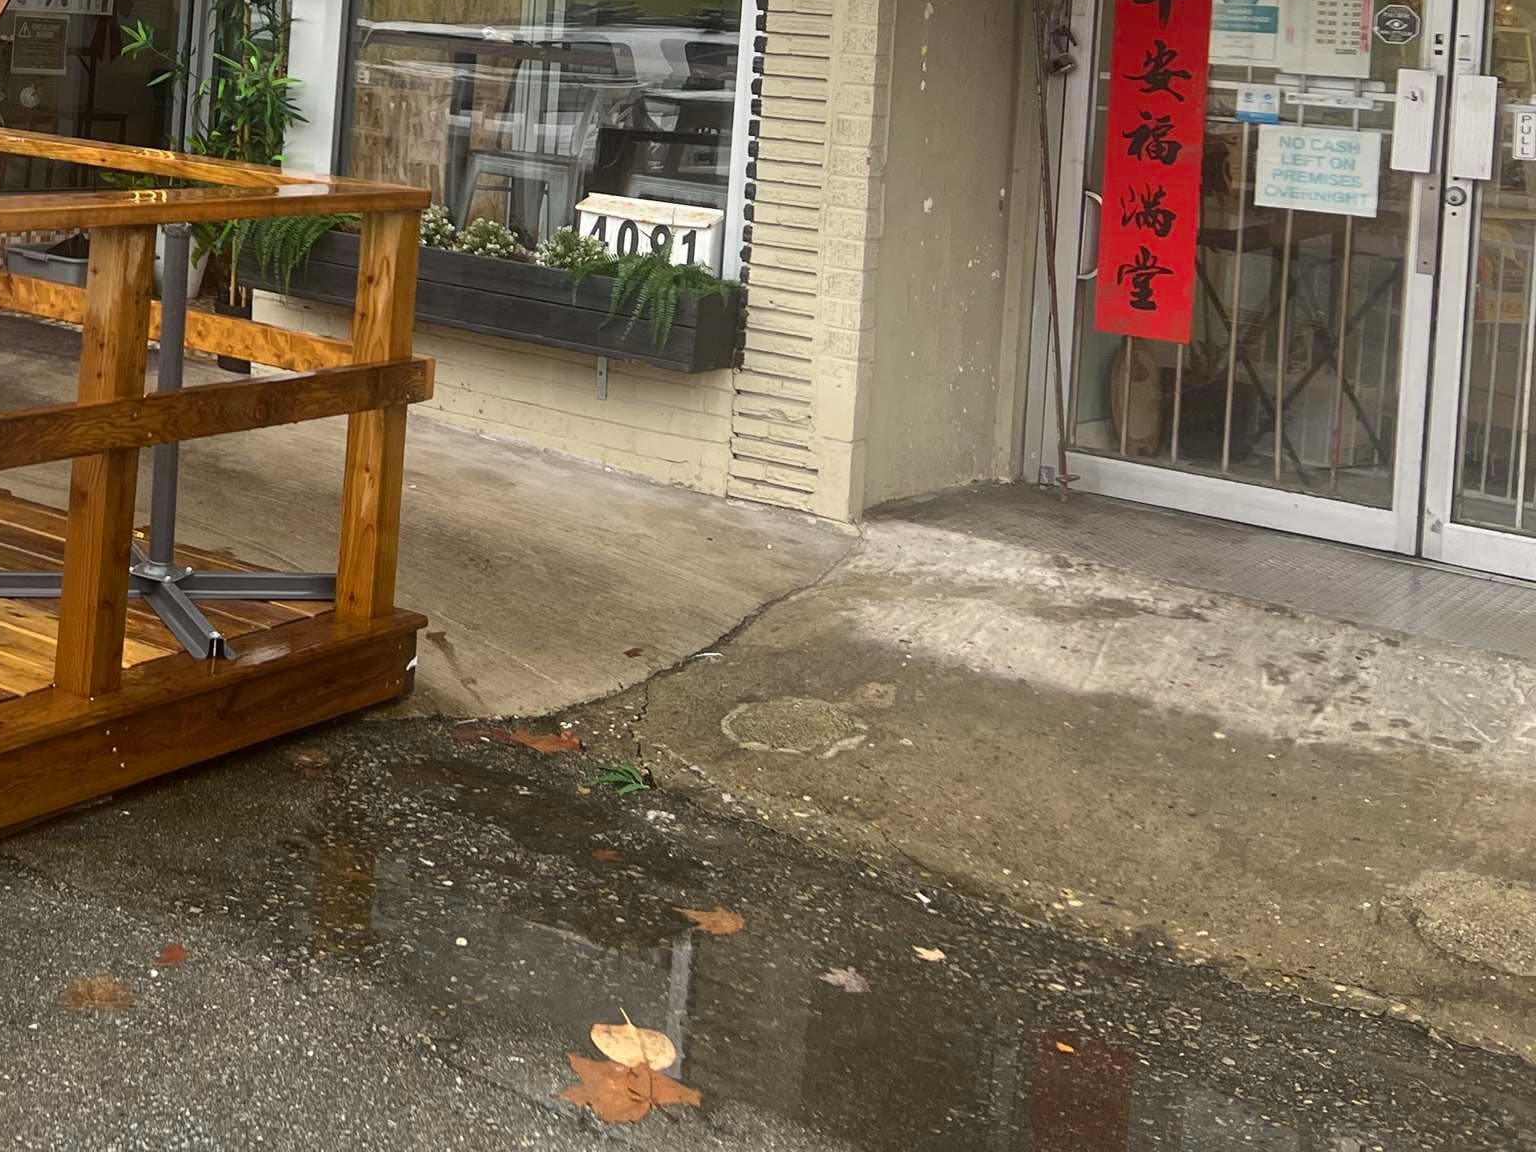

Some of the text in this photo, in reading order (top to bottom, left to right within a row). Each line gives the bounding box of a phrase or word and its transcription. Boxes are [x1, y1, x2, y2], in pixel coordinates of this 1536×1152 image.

[1279, 135, 1361, 154] NO CASH
[1521, 114, 1533, 156] PULL
[1281, 153, 1356, 171] LEFT ON
[1272, 168, 1362, 188] PREMISES
[1265, 184, 1369, 206] OVERNIGHT
